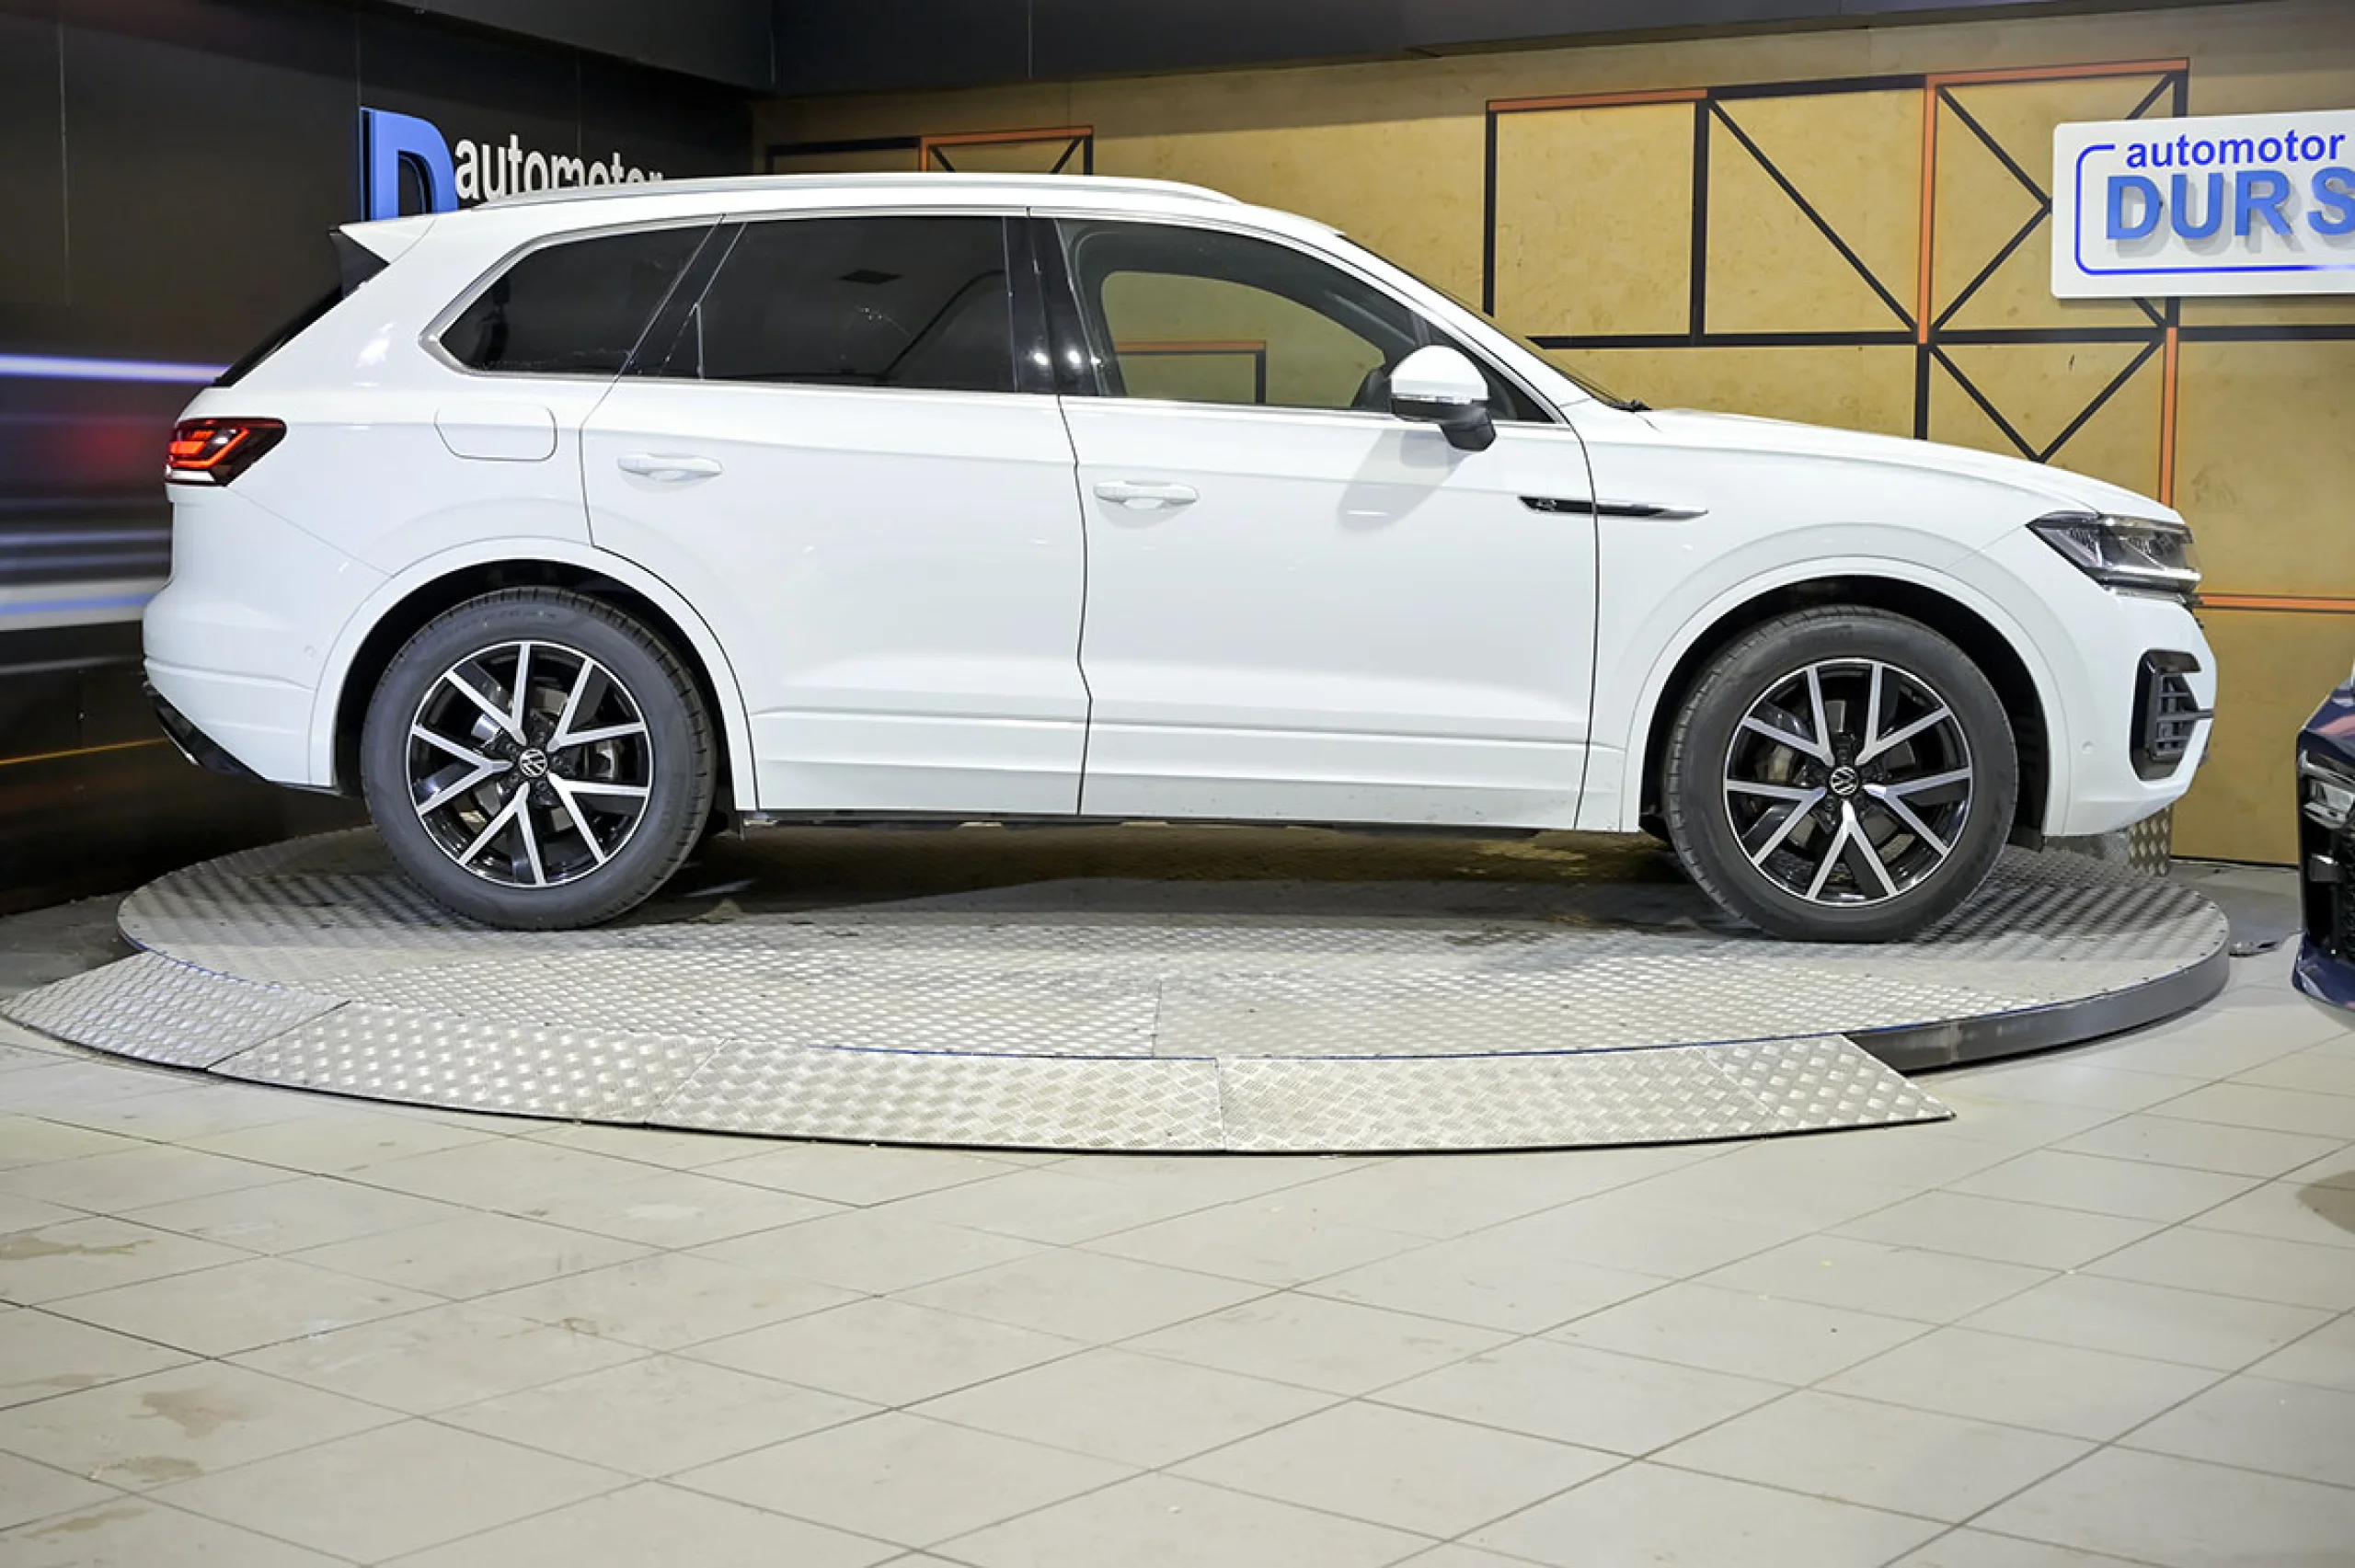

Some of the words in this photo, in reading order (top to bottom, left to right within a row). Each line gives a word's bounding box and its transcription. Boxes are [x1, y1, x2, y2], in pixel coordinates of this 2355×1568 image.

[455, 133, 663, 202] automot
[2126, 130, 2346, 168] automotor
[2106, 166, 2355, 240] DURS
